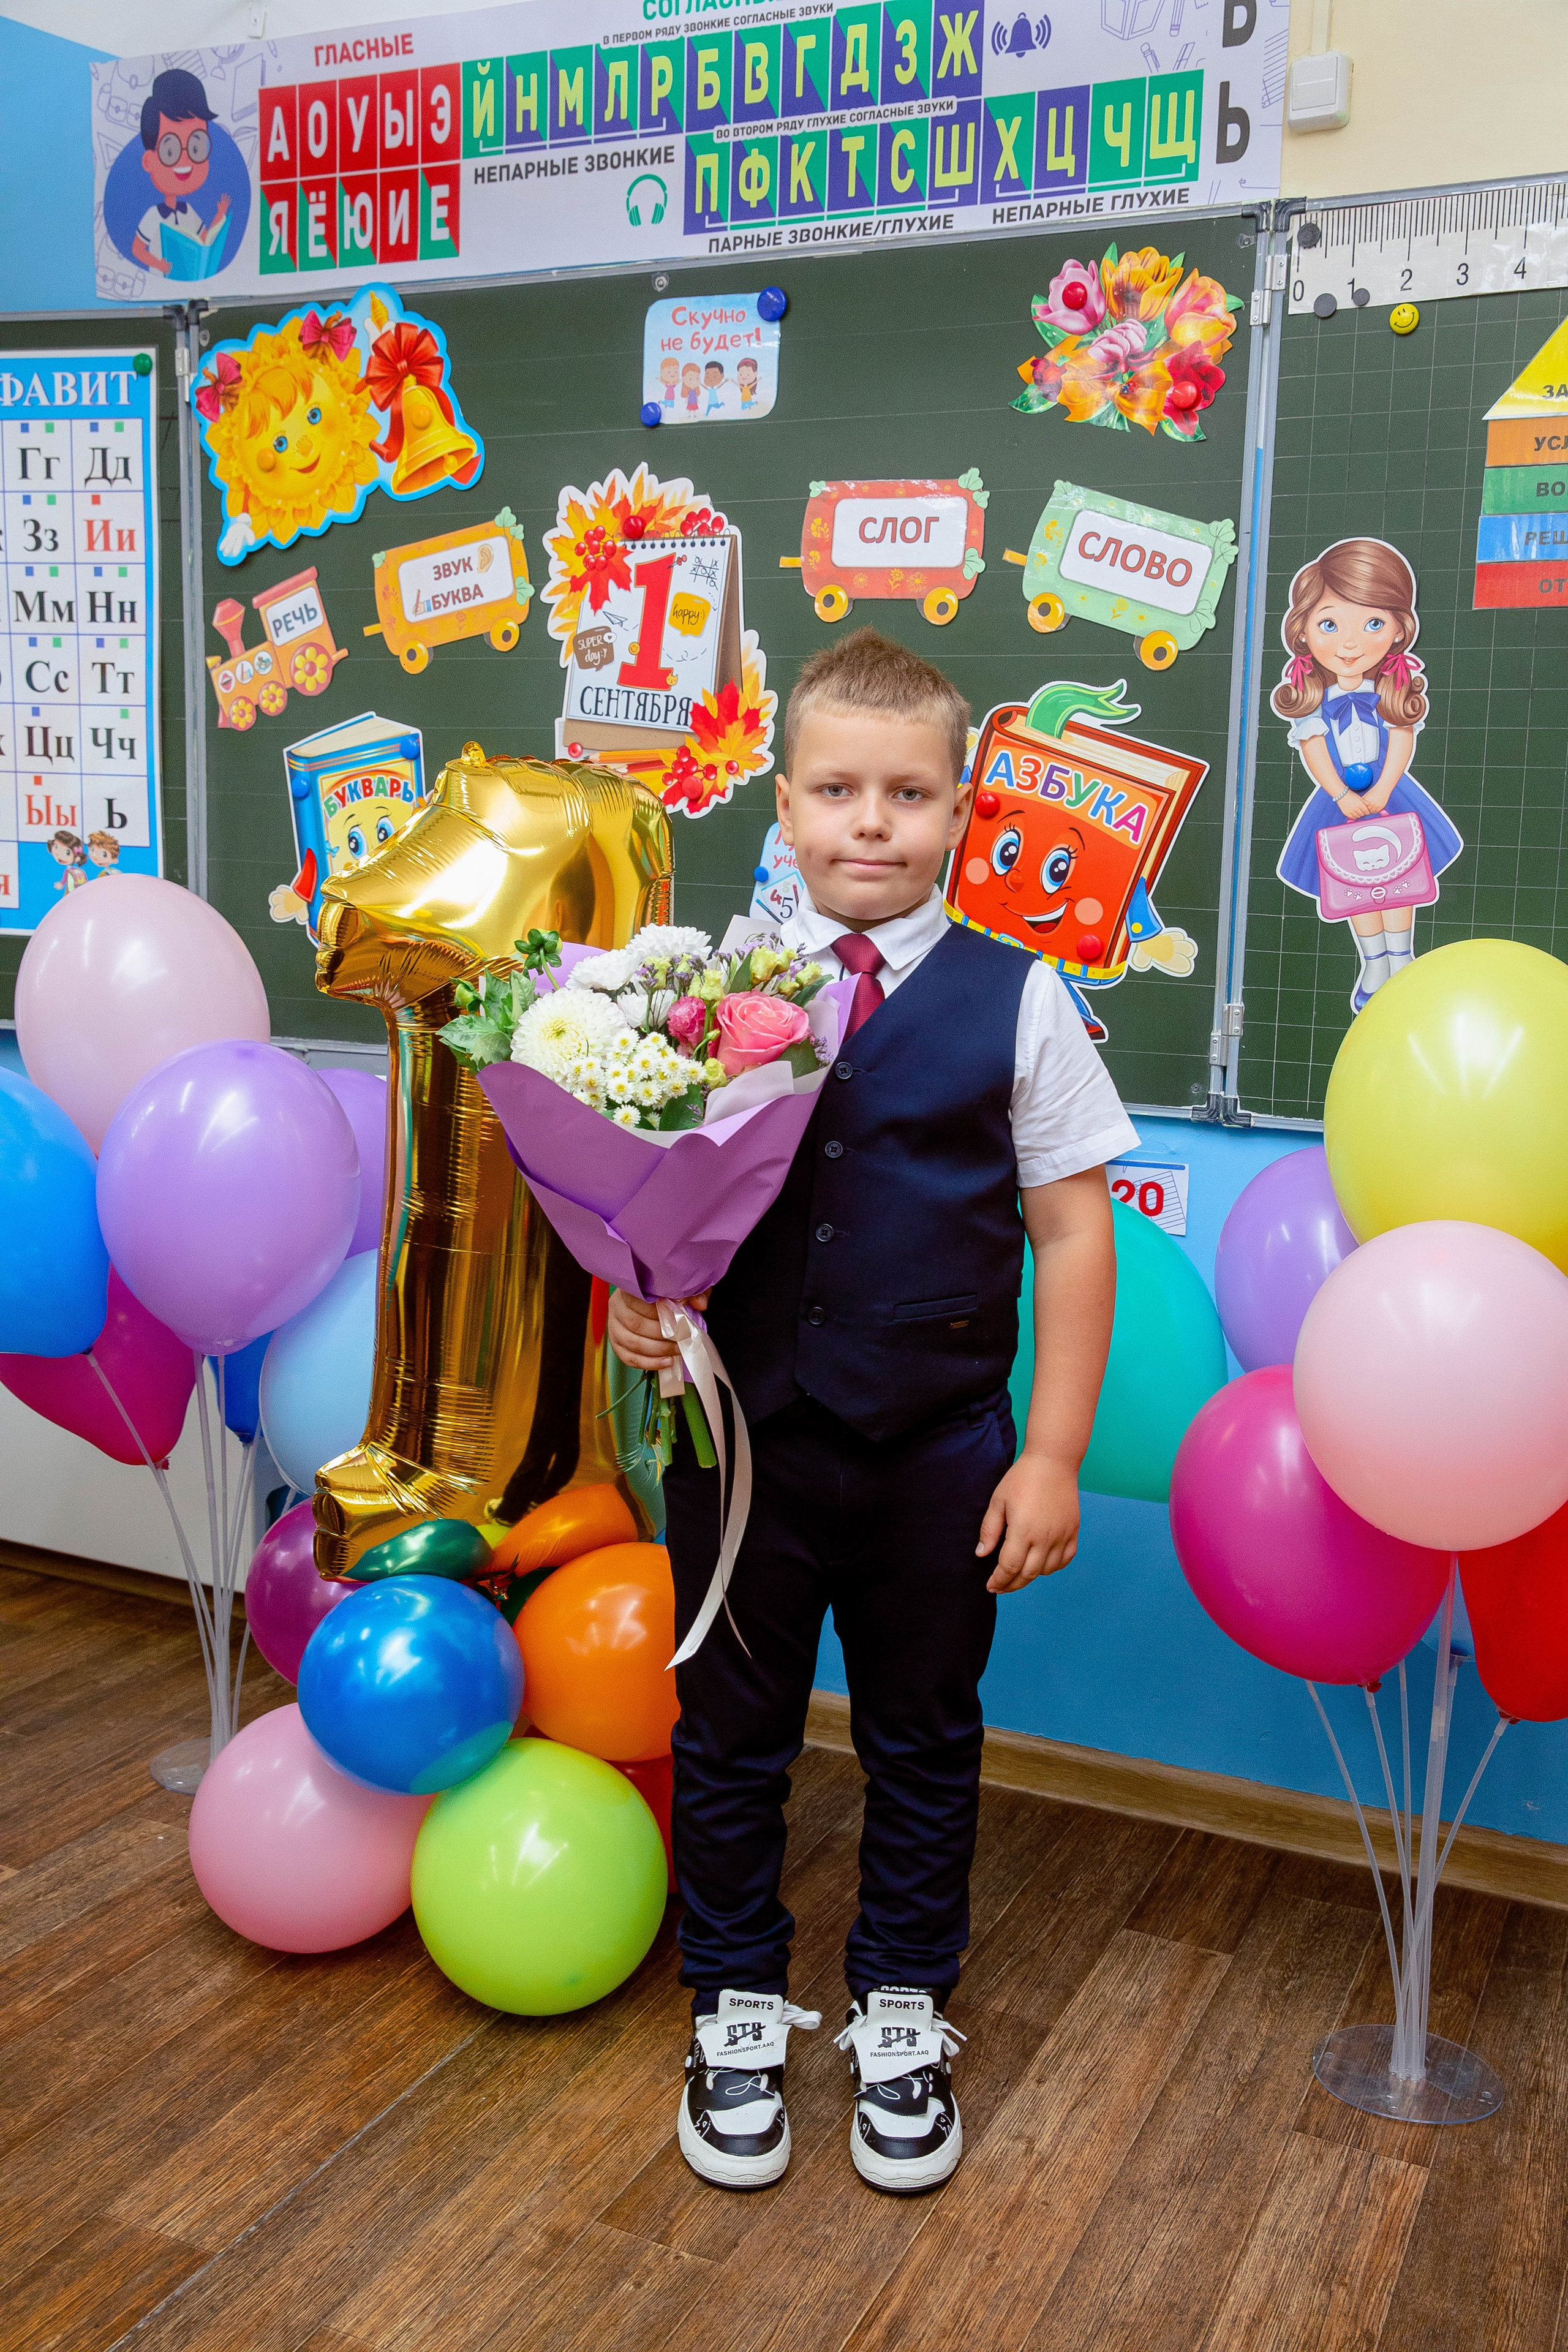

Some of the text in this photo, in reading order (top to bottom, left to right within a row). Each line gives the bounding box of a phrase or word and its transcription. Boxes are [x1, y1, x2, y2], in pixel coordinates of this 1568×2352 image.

[603, 36, 610, 45] В
[612, 29, 652, 43] ПЕРВОМ
[655, 24, 681, 40] РЯДУ
[684, 18, 731, 33] ЗВОНКИЕ
[734, 8, 796, 26] СОГЛАСНЫЕ
[799, 2, 834, 17] ЗВУКИ
[315, 32, 415, 67] ГЛАСНЫЕ
[716, 100, 954, 139] ВО ВТОРОМ РЯДУ ГЛУХИЕ СОГЛАСНЫЕ ЗВУКИ
[1216, 81, 1251, 164] Ь
[474, 145, 675, 185] НЕПАРНЫЕ ЗВОНКИЕ
[992, 187, 1190, 225] НЕПАРНЫЕ ГЛУХИЕ
[708, 214, 955, 254] ПАРНЫЕ ЗВОНКИЕ/ГЛУХИЕ
[1292, 257, 1527, 302] 0 1 2 3 4
[671, 306, 746, 330] Скучно
[660, 326, 762, 355] не будет!
[18, 448, 132, 489] Гг Дд
[83, 519, 137, 552] Ии
[858, 516, 940, 544] СЛОГ
[432, 556, 473, 581] ЗВУК
[1077, 530, 1193, 587] СЛОВО
[12, 590, 138, 624] Мм Нн
[431, 583, 484, 611] БУКВА
[272, 603, 318, 638] РЕЧЬ
[617, 552, 677, 692] 1
[578, 635, 604, 650] SUPER
[25, 660, 135, 695] Сс Тт
[579, 685, 692, 726] СЕНТЯБРЯ
[24, 726, 75, 766] Цц
[89, 727, 137, 760] Чч
[25, 794, 77, 827] Ыы
[323, 776, 414, 817] БУКВАРЬ
[985, 751, 1148, 843] АЗБУКА
[780, 897, 793, 919] 5
[1112, 1179, 1164, 1216] 20
[729, 1998, 774, 2010] SPORTS
[879, 1999, 925, 2010] SPORTS
